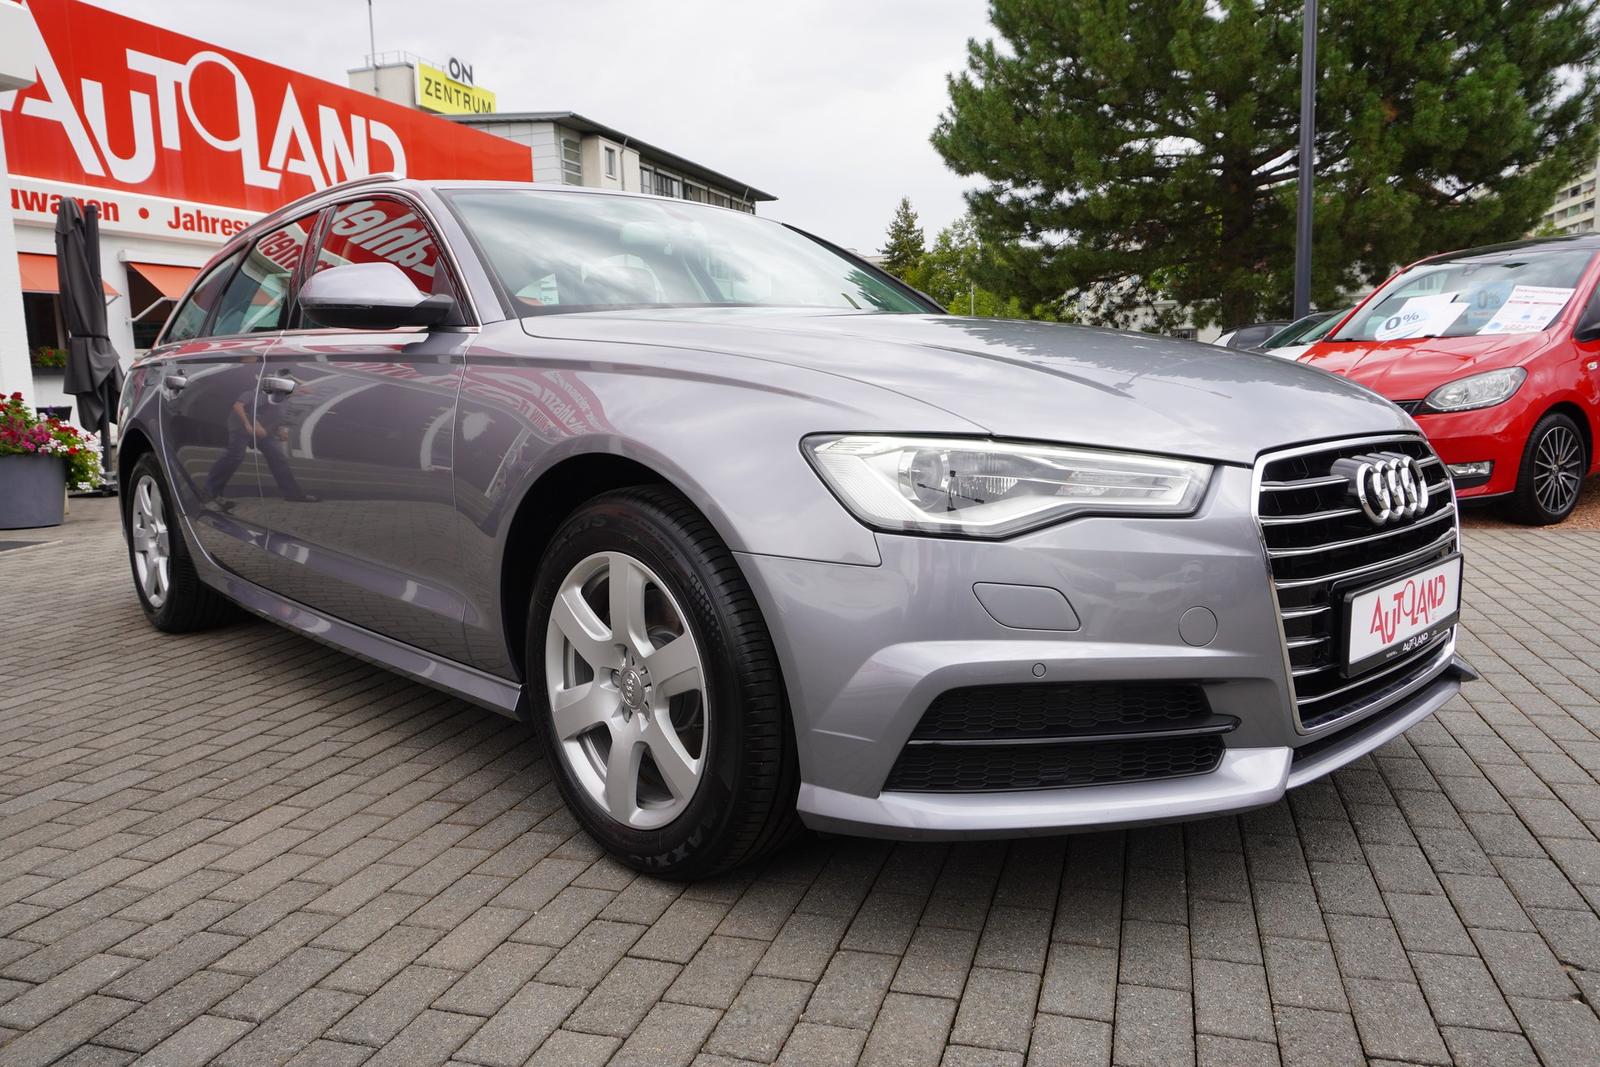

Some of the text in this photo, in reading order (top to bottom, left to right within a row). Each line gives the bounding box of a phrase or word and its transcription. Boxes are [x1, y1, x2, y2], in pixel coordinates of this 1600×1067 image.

[448, 57, 474, 85] ON
[424, 76, 492, 113] ZENTRUM
[167, 206, 249, 236] Jahres
[1385, 312, 1419, 331] 0%
[1370, 574, 1446, 645] AUTOLAND
